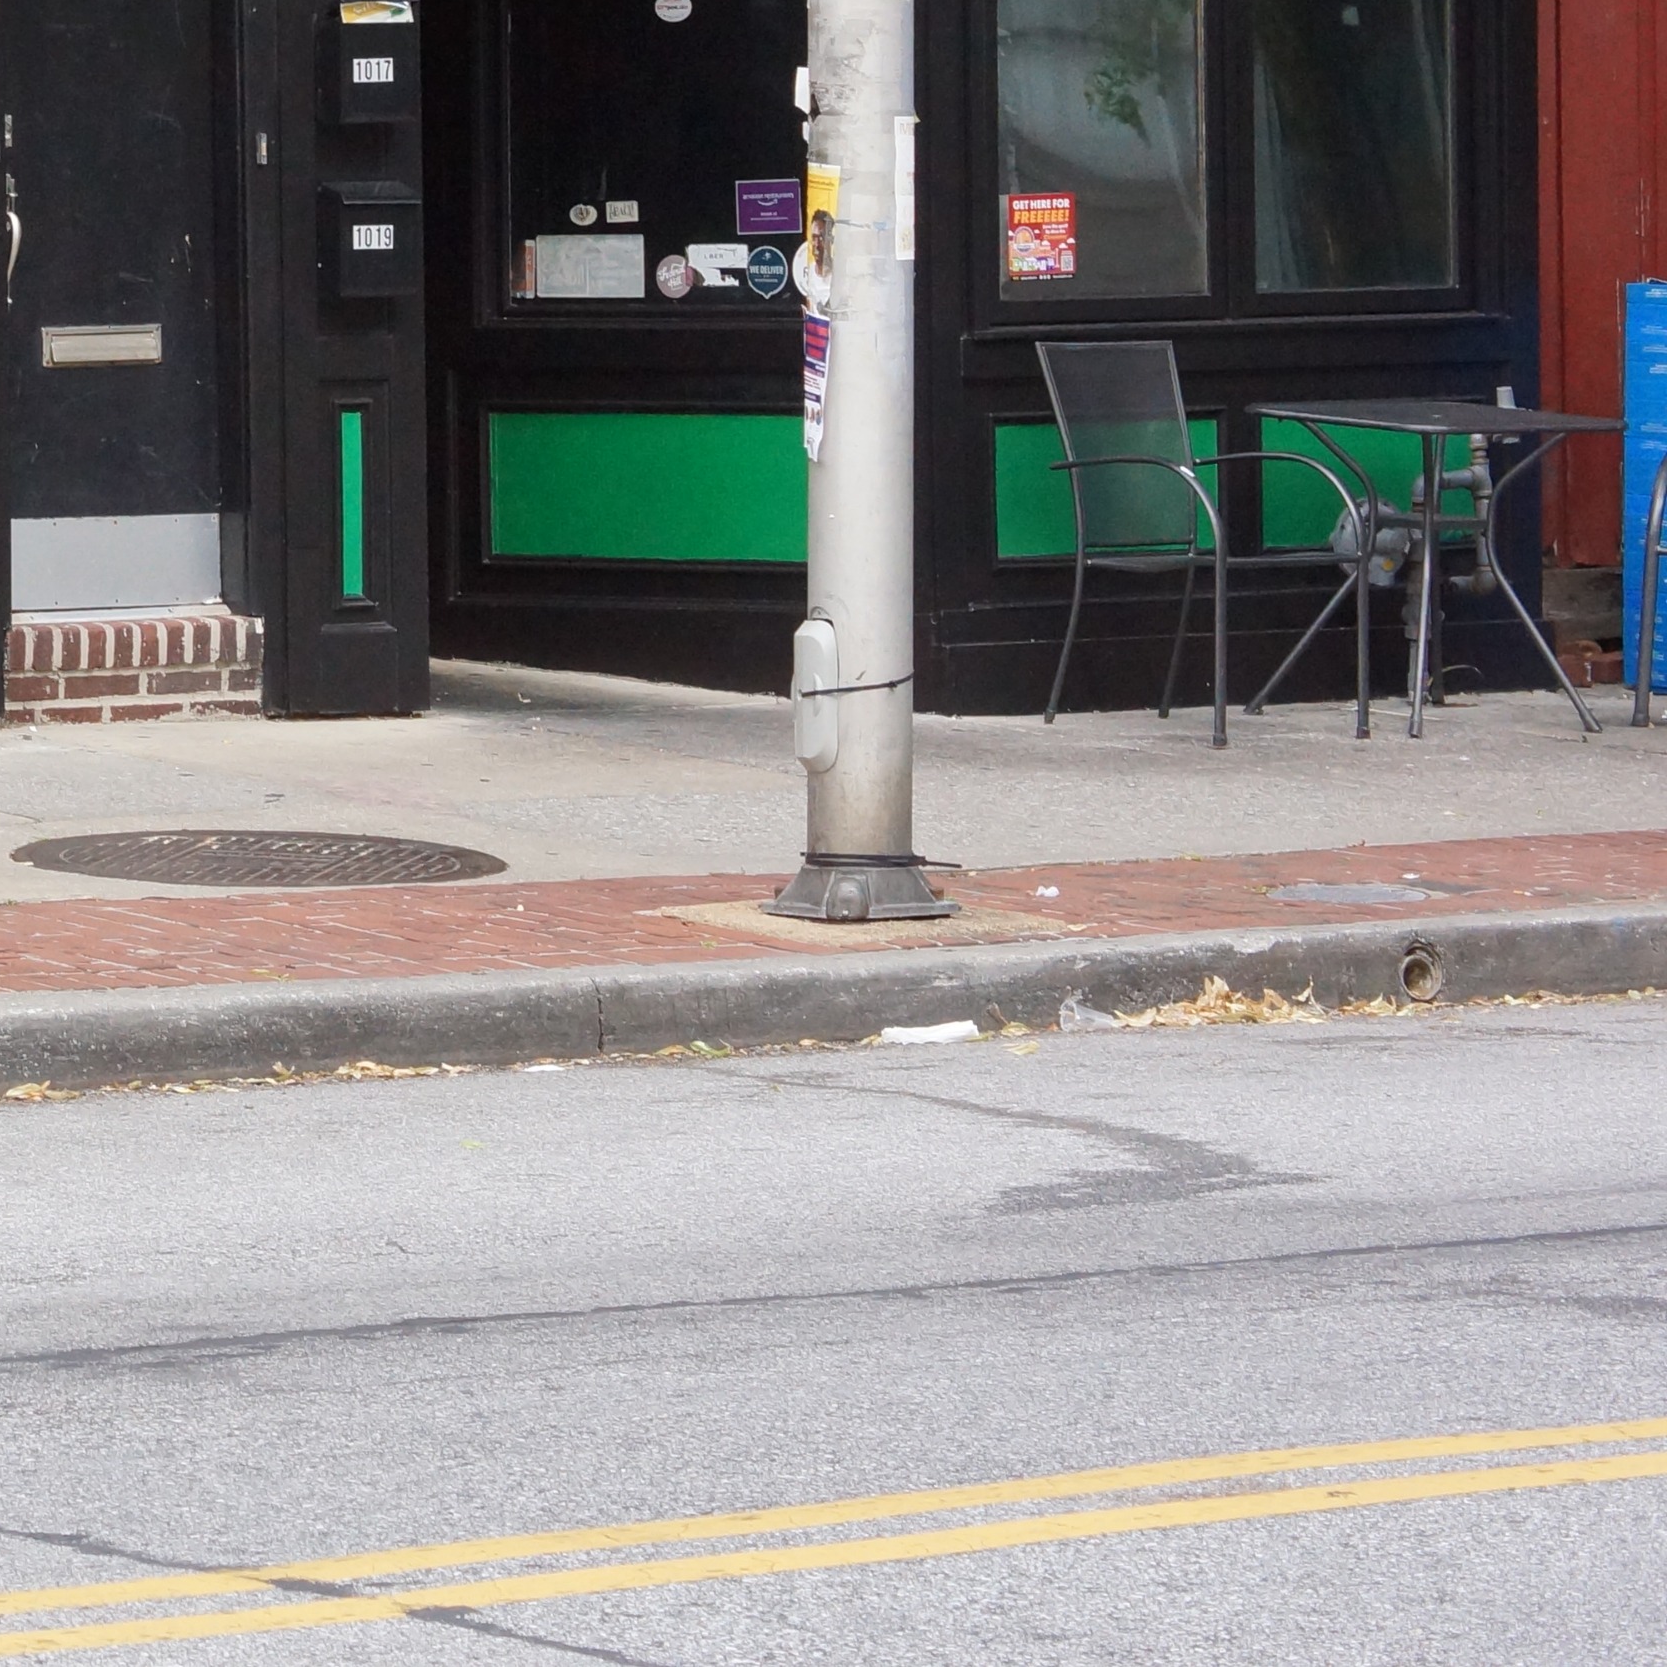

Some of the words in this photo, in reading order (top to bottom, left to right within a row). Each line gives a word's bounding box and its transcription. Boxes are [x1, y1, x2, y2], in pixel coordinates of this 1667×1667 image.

[356, 60, 392, 81] 1017
[1012, 200, 1029, 210] GET
[1030, 199, 1051, 209] HERE
[1052, 198, 1071, 208] FOR
[1013, 209, 1070, 224] FREEEEE!
[355, 227, 392, 248] 1019
[749, 265, 759, 274] WE
[760, 265, 784, 275] DELIVER
